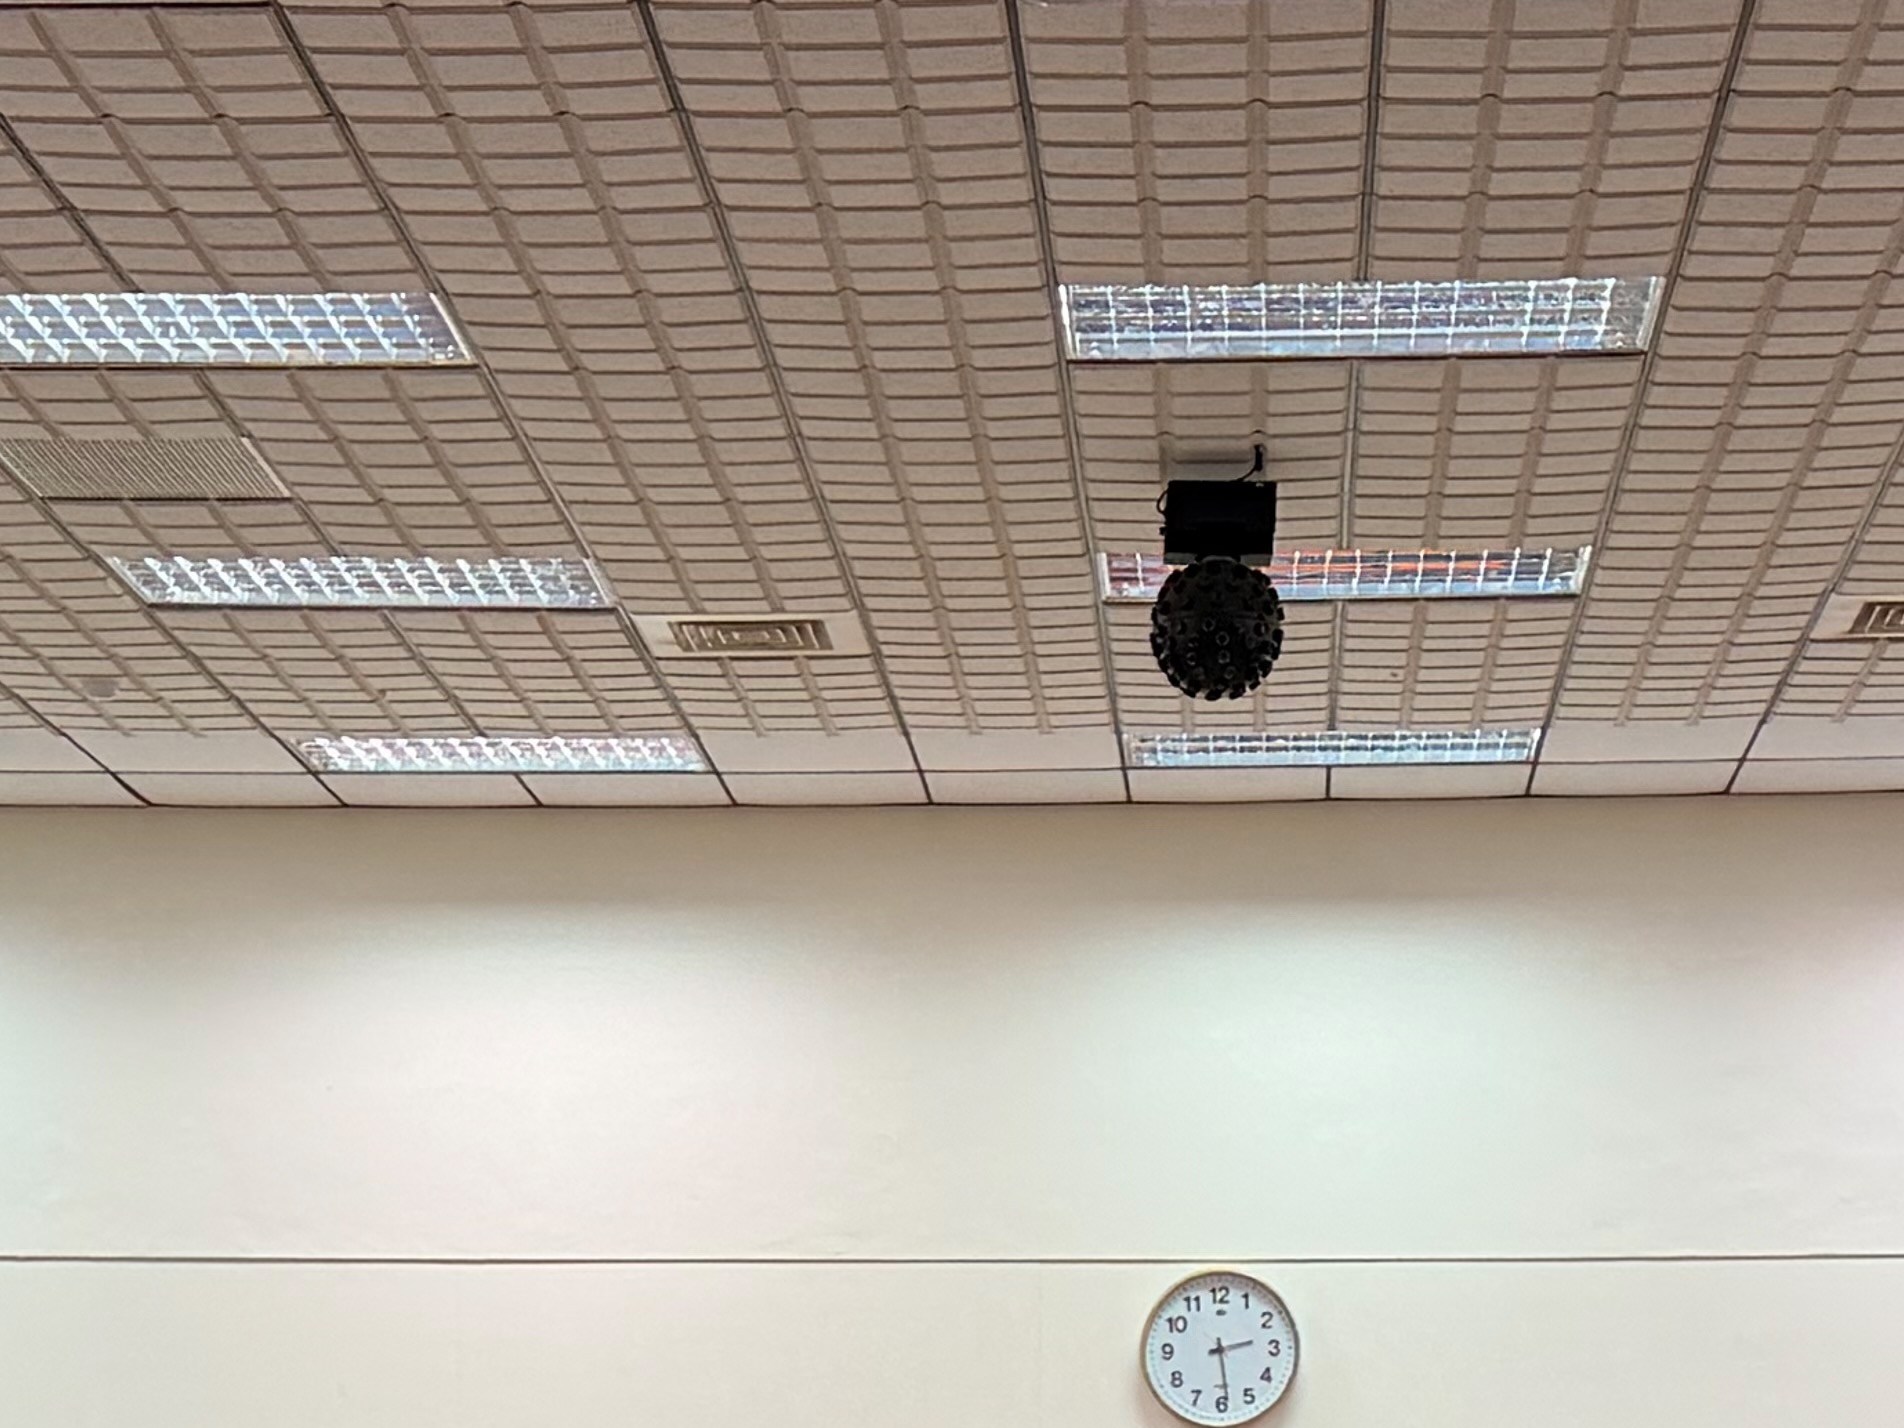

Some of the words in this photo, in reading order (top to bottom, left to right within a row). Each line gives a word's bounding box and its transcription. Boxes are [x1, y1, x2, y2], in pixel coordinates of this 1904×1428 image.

[1209, 1286, 1230, 1304] 12
[1241, 1293, 1250, 1309] 1
[1183, 1296, 1201, 1312] 11
[1166, 1316, 1188, 1333] 10
[1261, 1312, 1274, 1329] 2
[1161, 1343, 1175, 1360] 9
[1268, 1340, 1281, 1357] 3
[1170, 1371, 1184, 1388] 8
[1260, 1367, 1272, 1383] 4
[1191, 1389, 1202, 1407] 7
[1215, 1396, 1229, 1413] 6
[1243, 1388, 1256, 1405] 5
